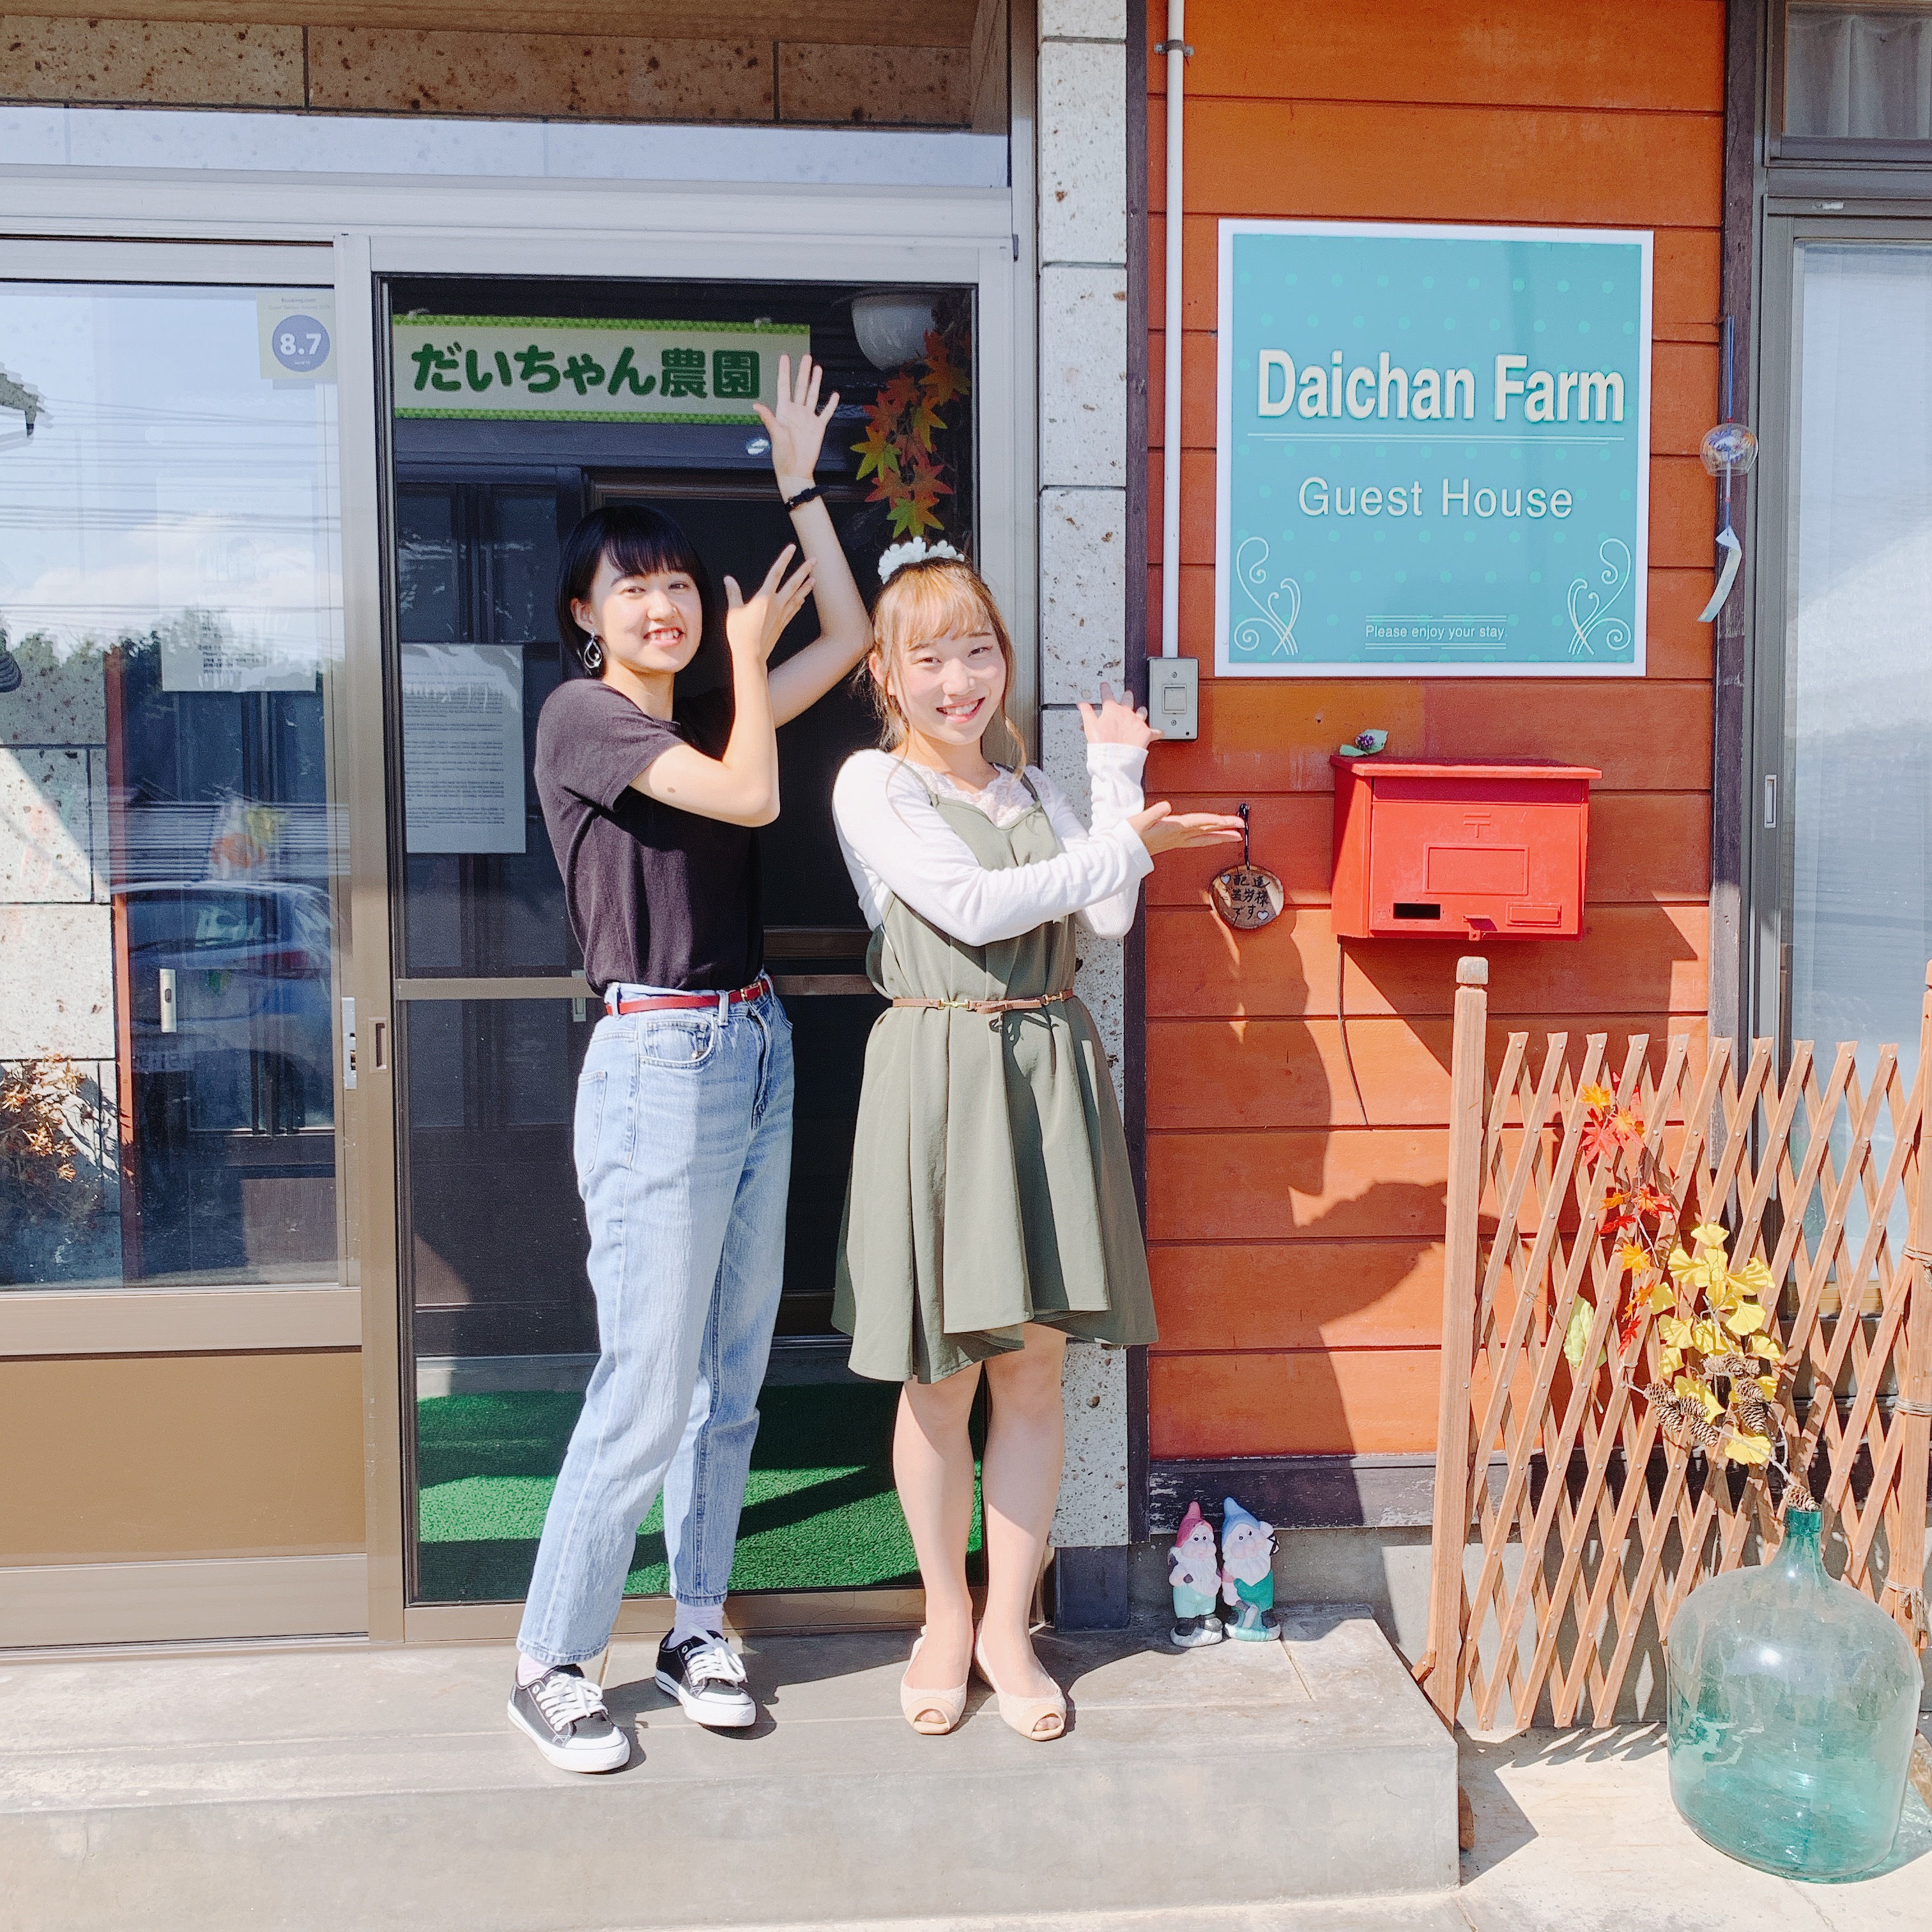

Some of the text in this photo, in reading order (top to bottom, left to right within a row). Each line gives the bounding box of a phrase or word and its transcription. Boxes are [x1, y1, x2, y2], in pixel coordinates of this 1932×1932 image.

[280, 333, 321, 355] 8.7
[411, 341, 760, 399] だいちゃん農園
[1257, 348, 1625, 423] Daichan Farm
[1298, 476, 1574, 518] Guest House
[1365, 624, 1507, 640] Please enjoy your stay.
[1232, 904, 1256, 924] です
